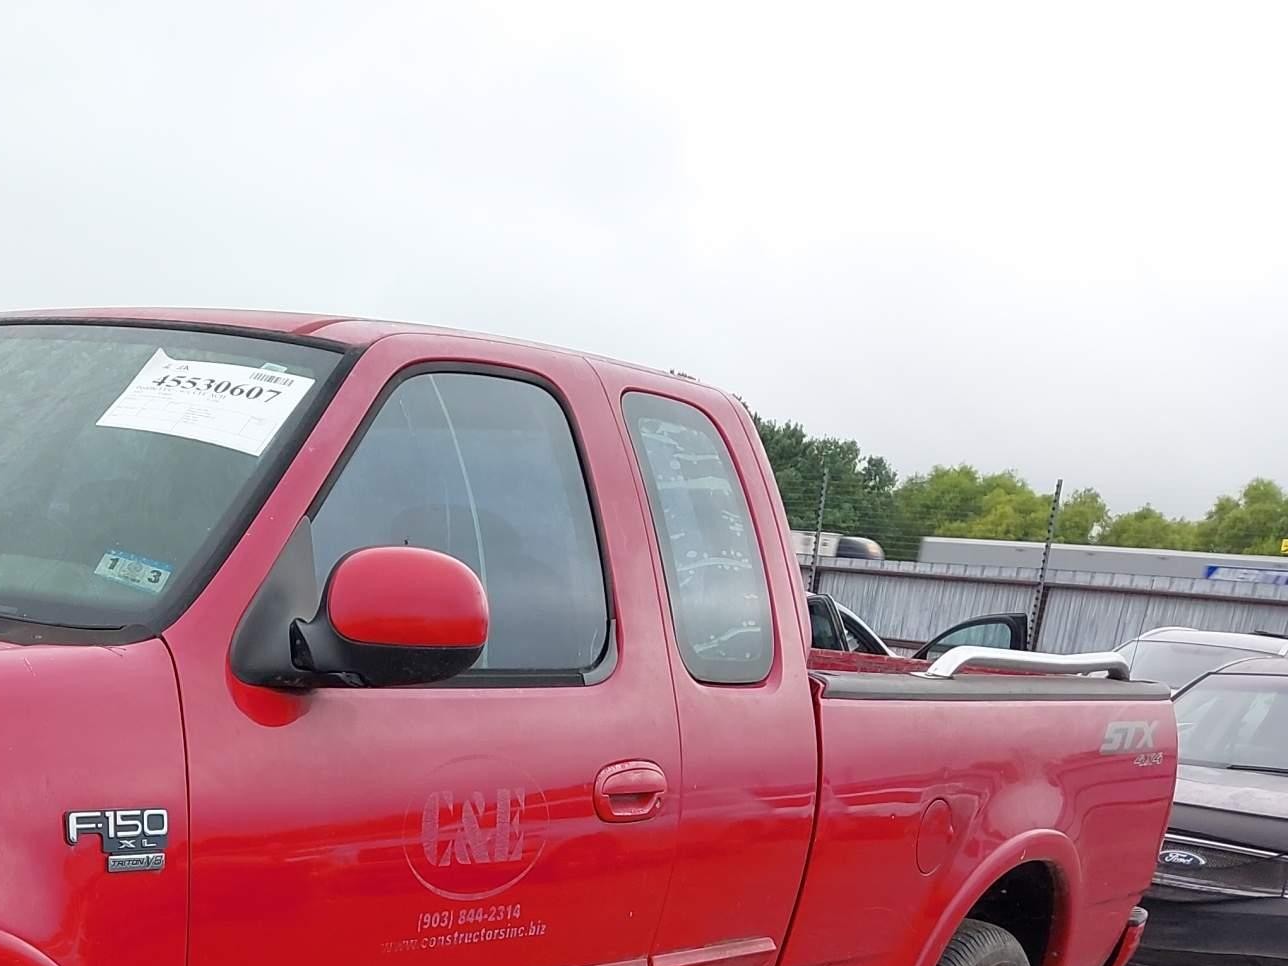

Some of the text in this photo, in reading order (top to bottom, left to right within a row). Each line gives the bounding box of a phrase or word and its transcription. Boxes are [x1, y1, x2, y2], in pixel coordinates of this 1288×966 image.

[152, 374, 283, 404] 45530607
[147, 569, 162, 584] 3
[1099, 720, 1161, 755] STX
[421, 787, 526, 867] C&E
[1164, 852, 1193, 865] Ford
[417, 903, 521, 933] (903) 844-2314
